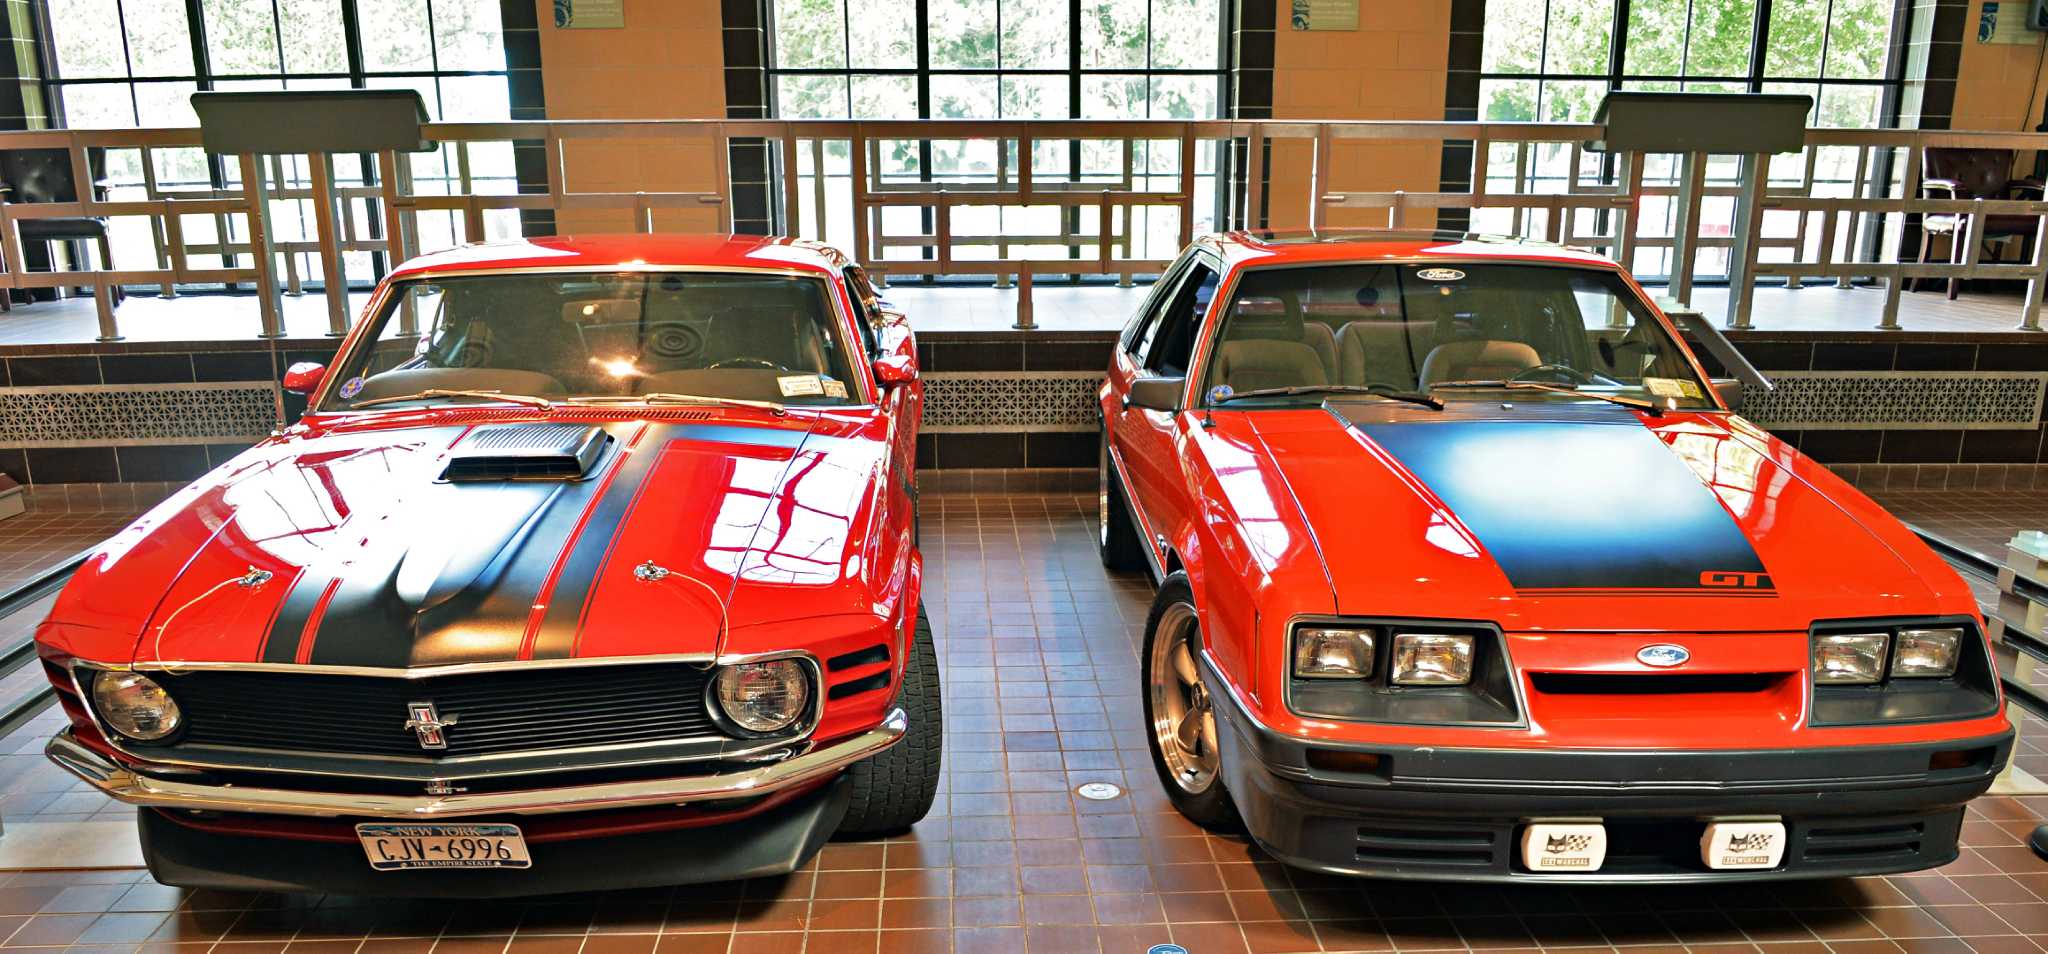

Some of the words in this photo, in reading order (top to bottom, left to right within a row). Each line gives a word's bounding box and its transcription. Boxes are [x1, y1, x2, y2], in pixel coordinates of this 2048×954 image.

[1700, 571, 1770, 586] GT
[399, 826, 432, 837] NEW
[440, 826, 481, 837] YORK
[377, 838, 425, 860] CJV
[448, 838, 512, 860] 6996
